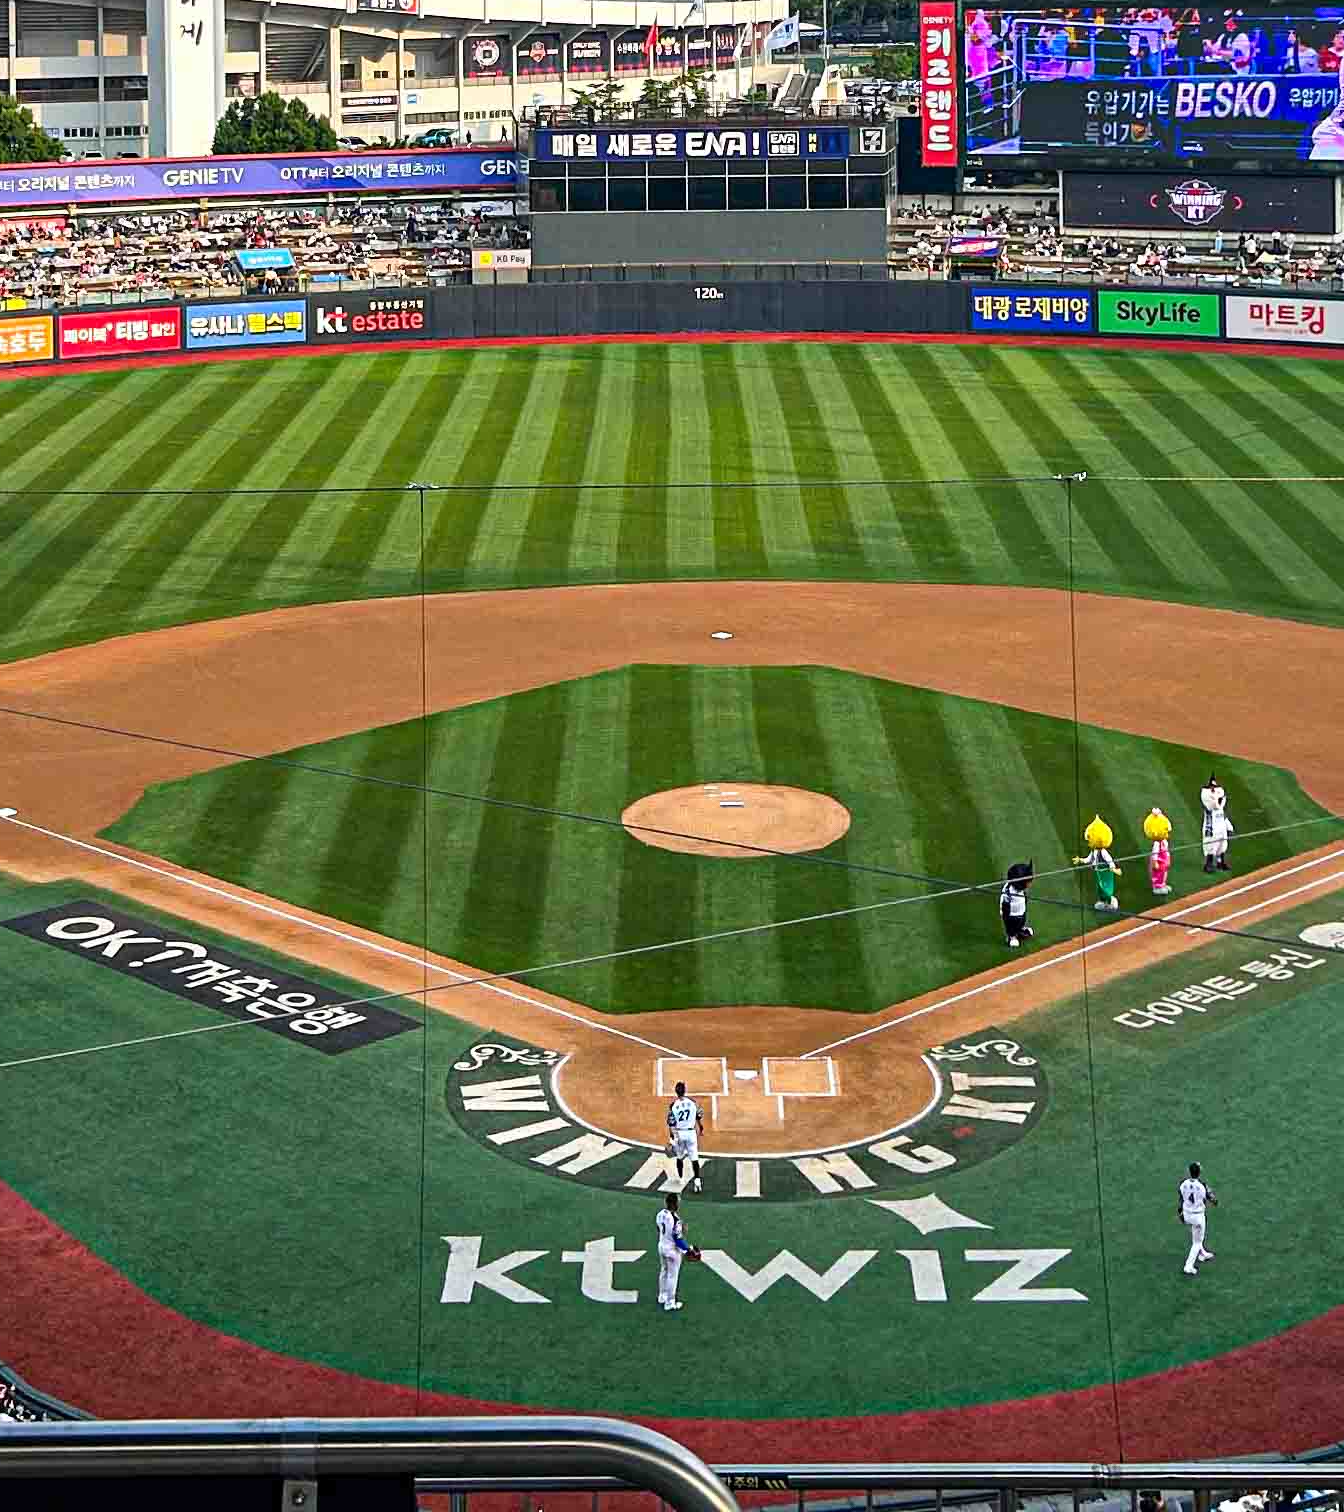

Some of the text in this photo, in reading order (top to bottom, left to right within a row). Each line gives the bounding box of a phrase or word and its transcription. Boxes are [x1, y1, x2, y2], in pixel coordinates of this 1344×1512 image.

[925, 28, 953, 151] 키즈랜드
[1175, 81, 1277, 118] BESKO
[552, 133, 598, 157] 매일
[606, 133, 677, 157] 새로운
[163, 167, 245, 186] GENIE TV
[331, 163, 383, 180] 오리지널
[1171, 193, 1221, 206] WINNING
[1187, 206, 1204, 218] KT
[317, 307, 424, 335] kt estate
[1117, 300, 1201, 327] SkyLife
[1250, 303, 1326, 336] 마트킹
[459, 1071, 1036, 1199] WINNING KT
[439, 1223, 1089, 1304] kt wiz
